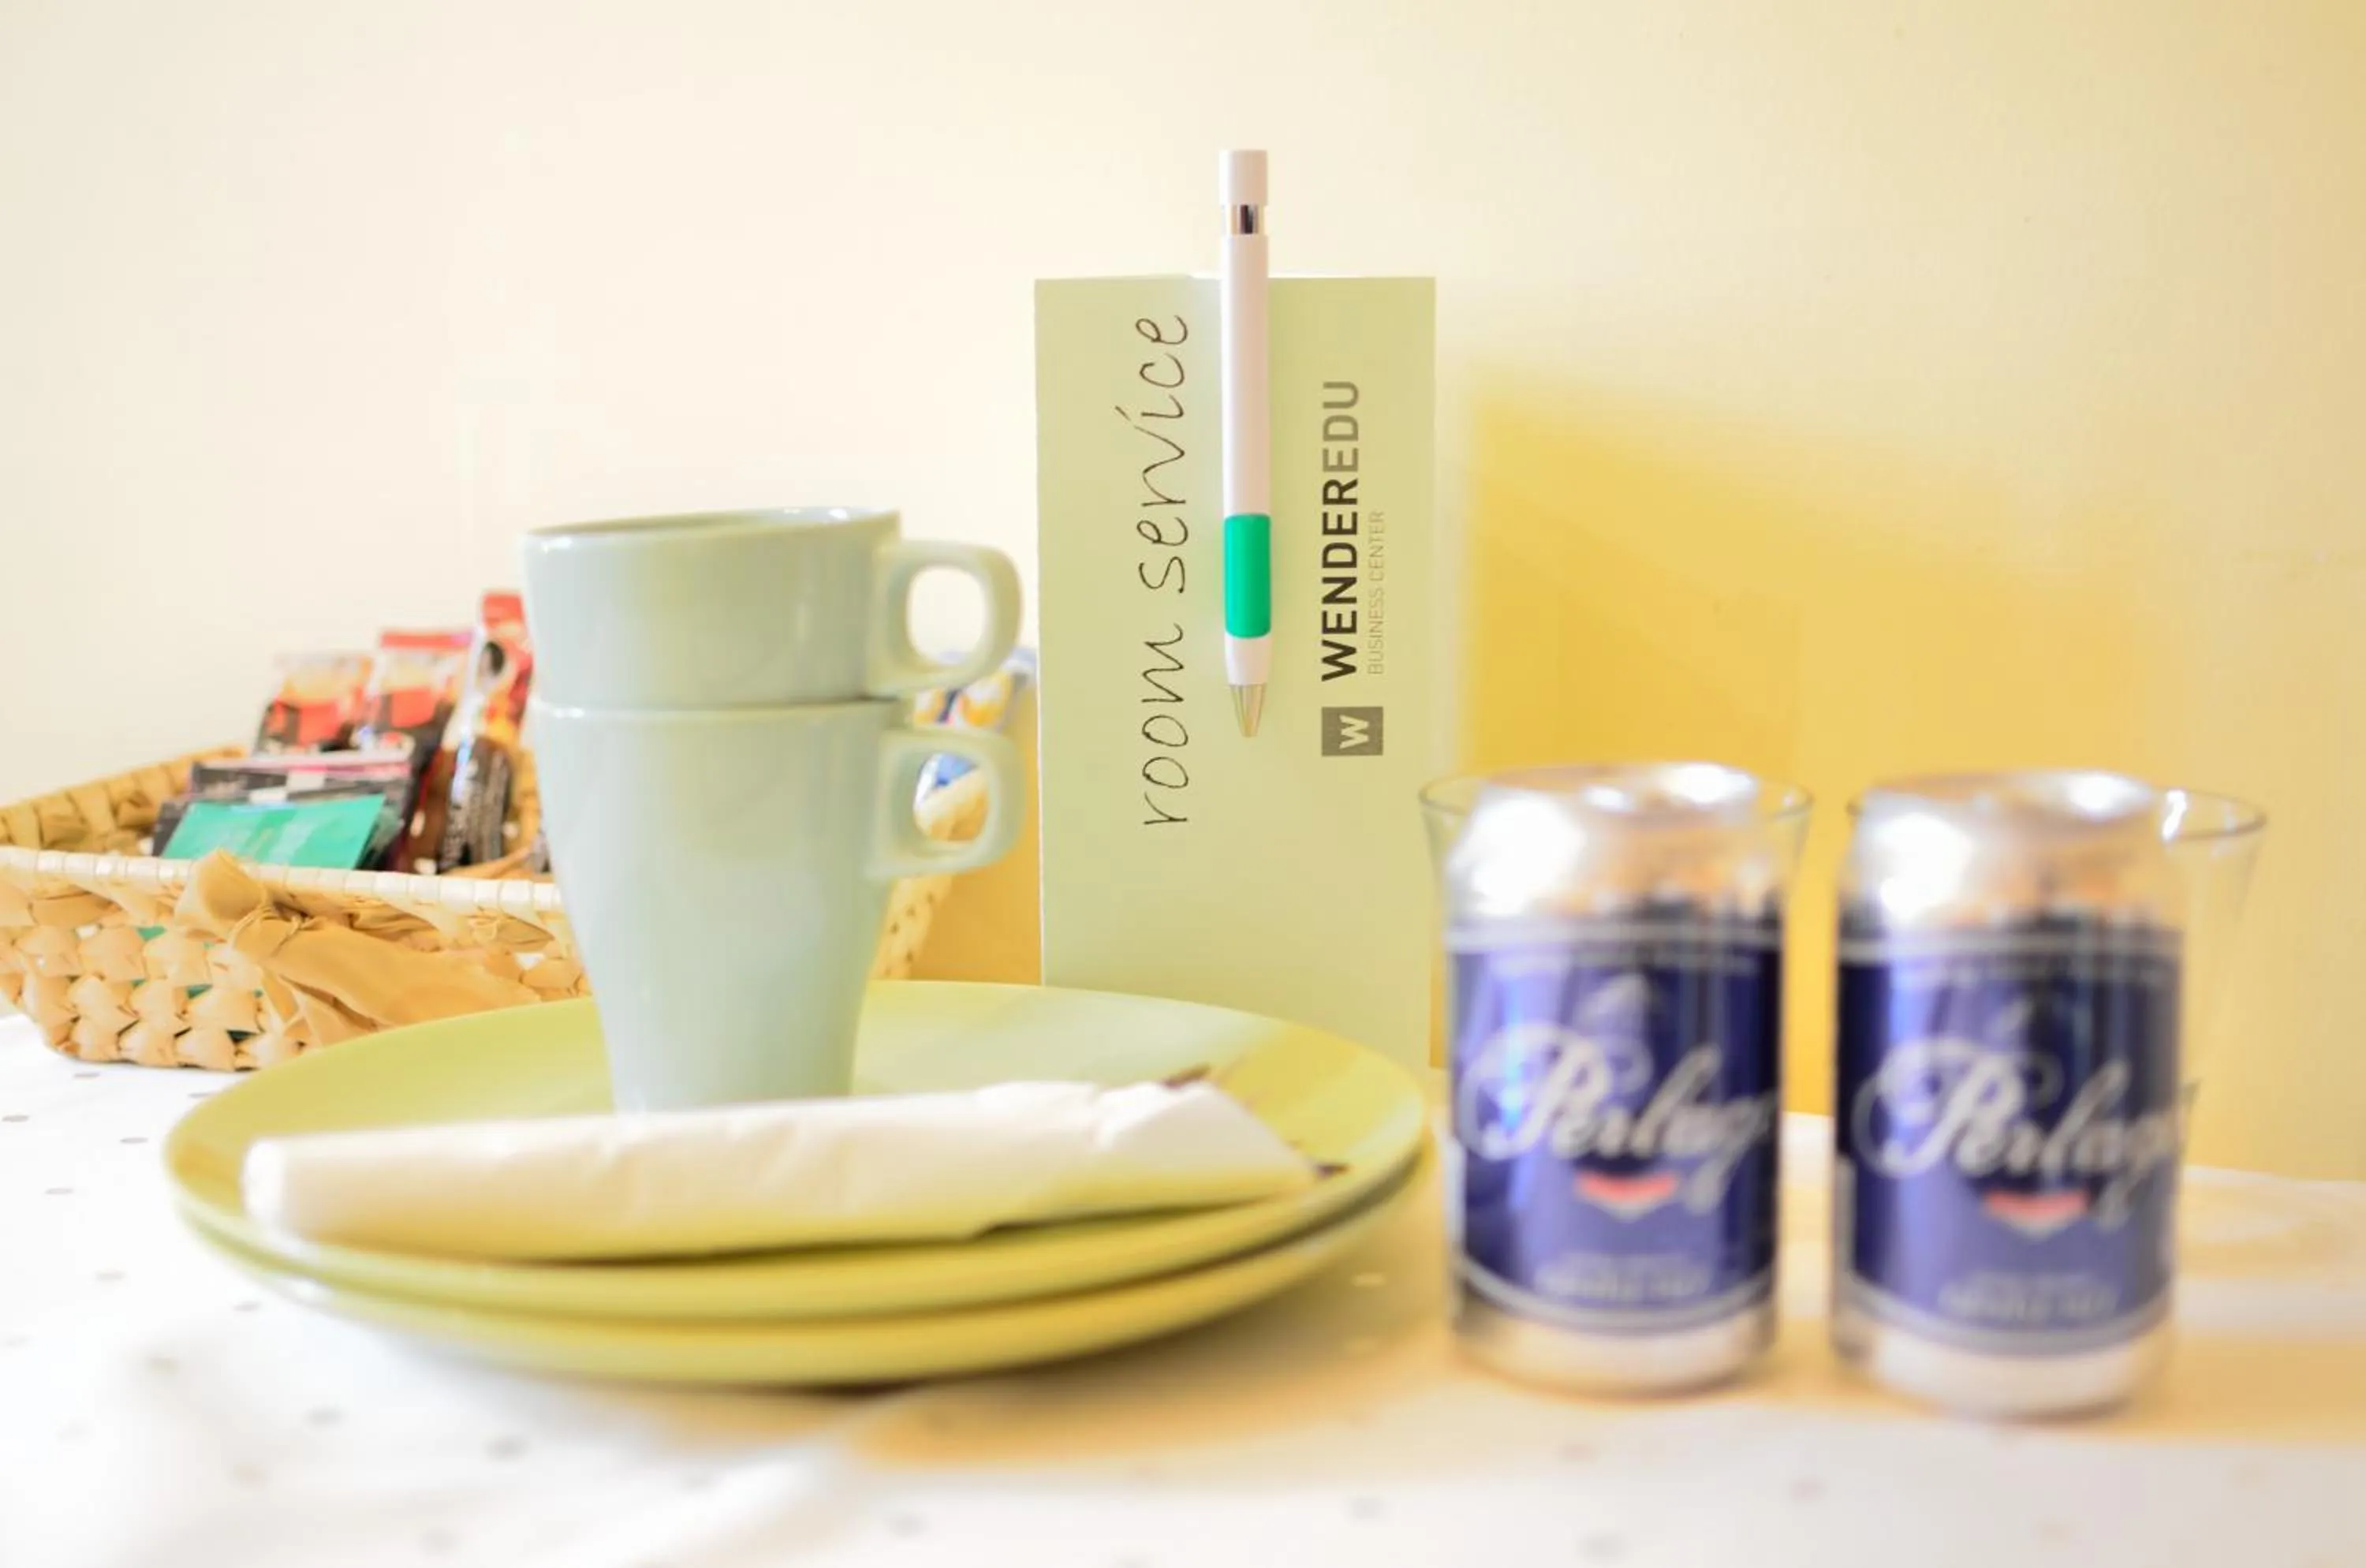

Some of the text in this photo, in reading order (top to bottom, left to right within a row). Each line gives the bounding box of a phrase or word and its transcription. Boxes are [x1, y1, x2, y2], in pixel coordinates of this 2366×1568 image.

[1114, 315, 1189, 825] room service
[1320, 381, 1360, 682] WENDEREDU
[1367, 510, 1385, 675] BUSINESS CENTER
[1338, 715, 1370, 750] W
